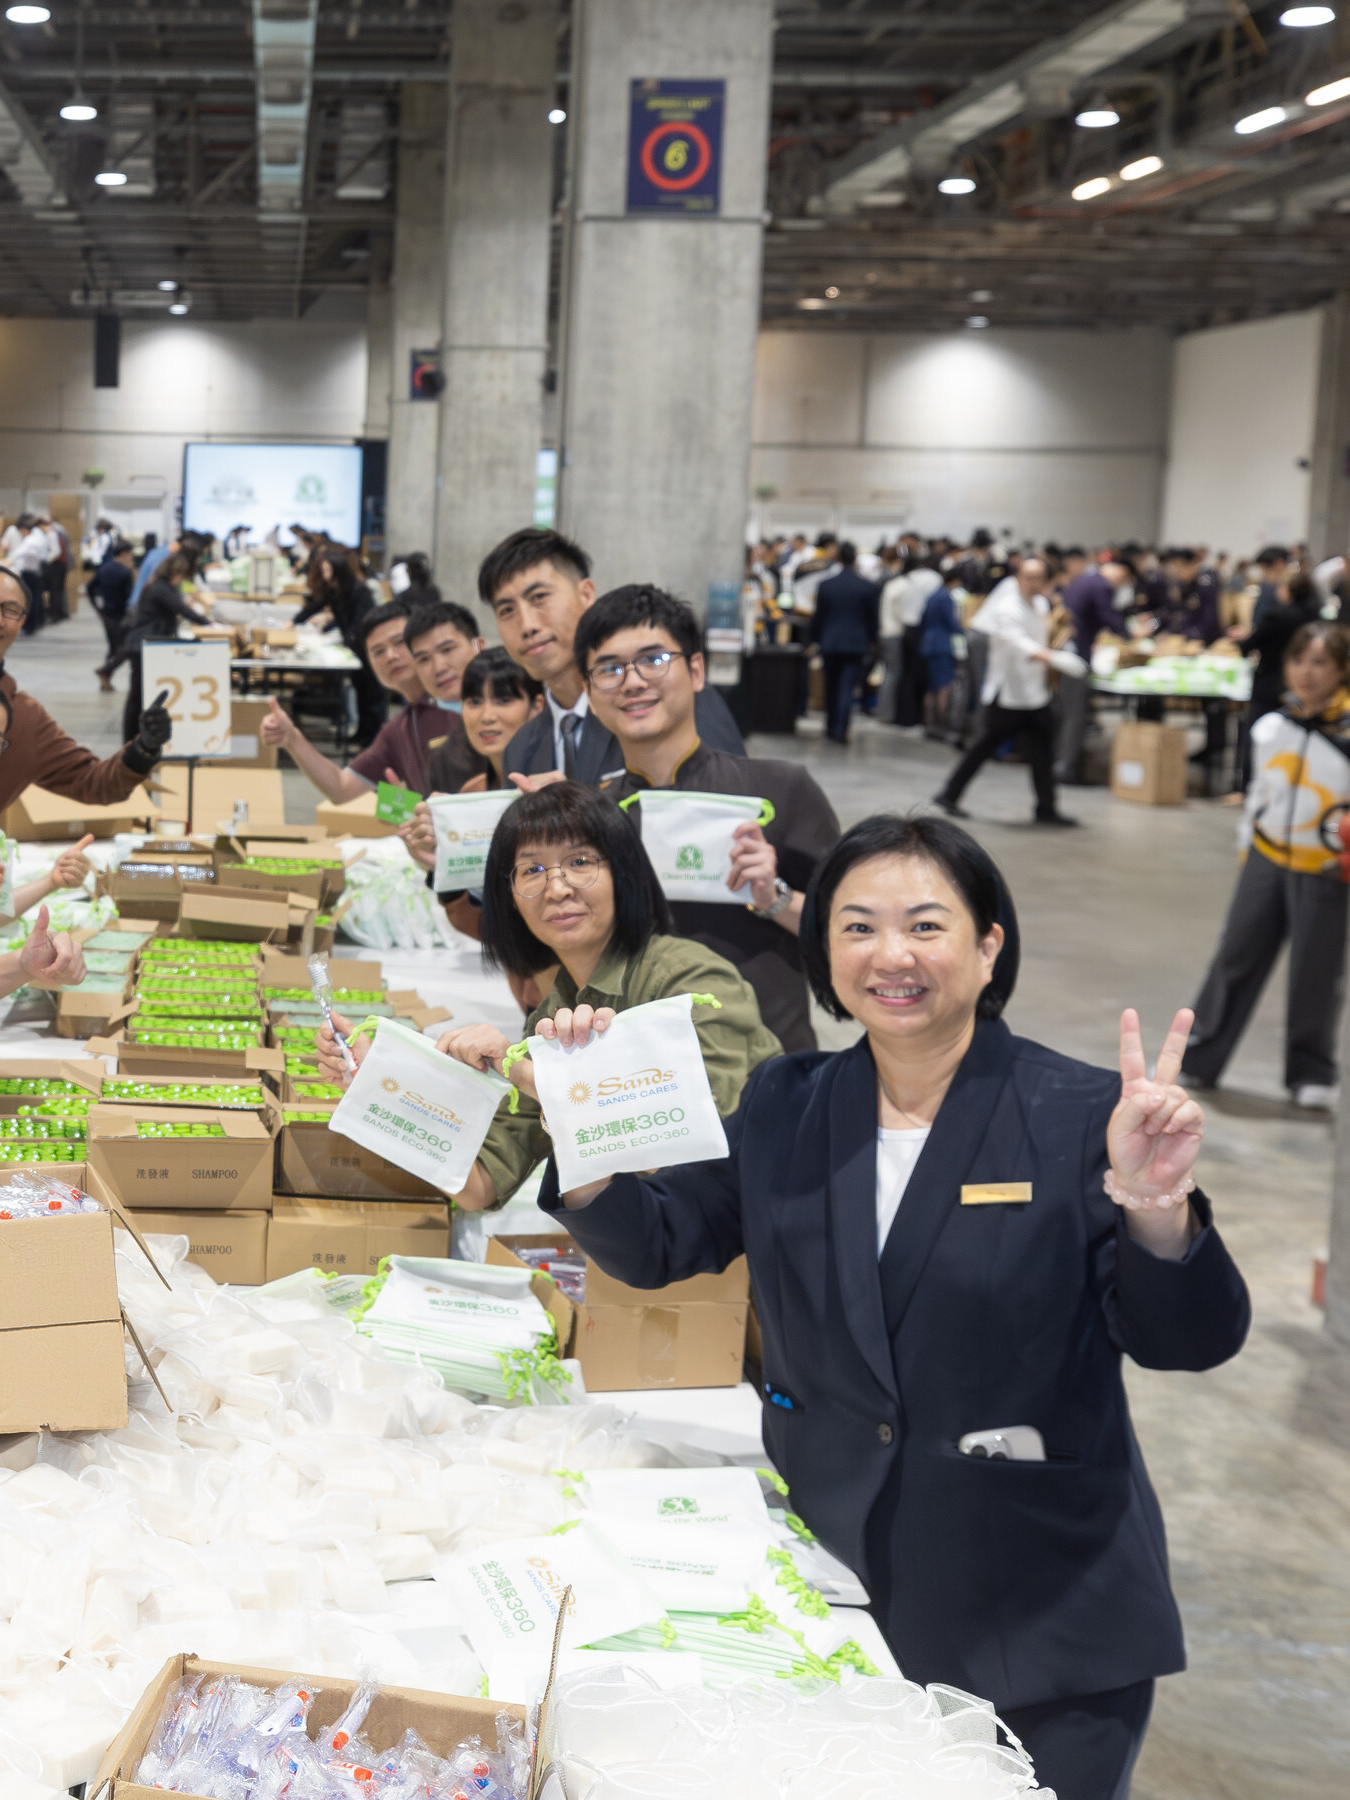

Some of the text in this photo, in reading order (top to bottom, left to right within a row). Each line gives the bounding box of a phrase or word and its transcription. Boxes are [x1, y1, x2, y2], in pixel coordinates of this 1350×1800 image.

[664, 139, 689, 171] 6
[155, 675, 220, 722] 23
[597, 1068, 677, 1096] Sands
[597, 1082, 678, 1107] SANDS CARES
[399, 1098, 461, 1133] SANDS CARES
[401, 1090, 465, 1126] Sands
[362, 1114, 399, 1138] SANDS
[367, 1103, 452, 1153] 金沙環保360
[574, 1107, 685, 1145] 金沙環保360
[579, 1141, 626, 1158] SANDS
[191, 1169, 238, 1179] SHAMPOO
[468, 1566, 490, 1596] SANDS
[482, 1560, 535, 1632] 金沙環保360
